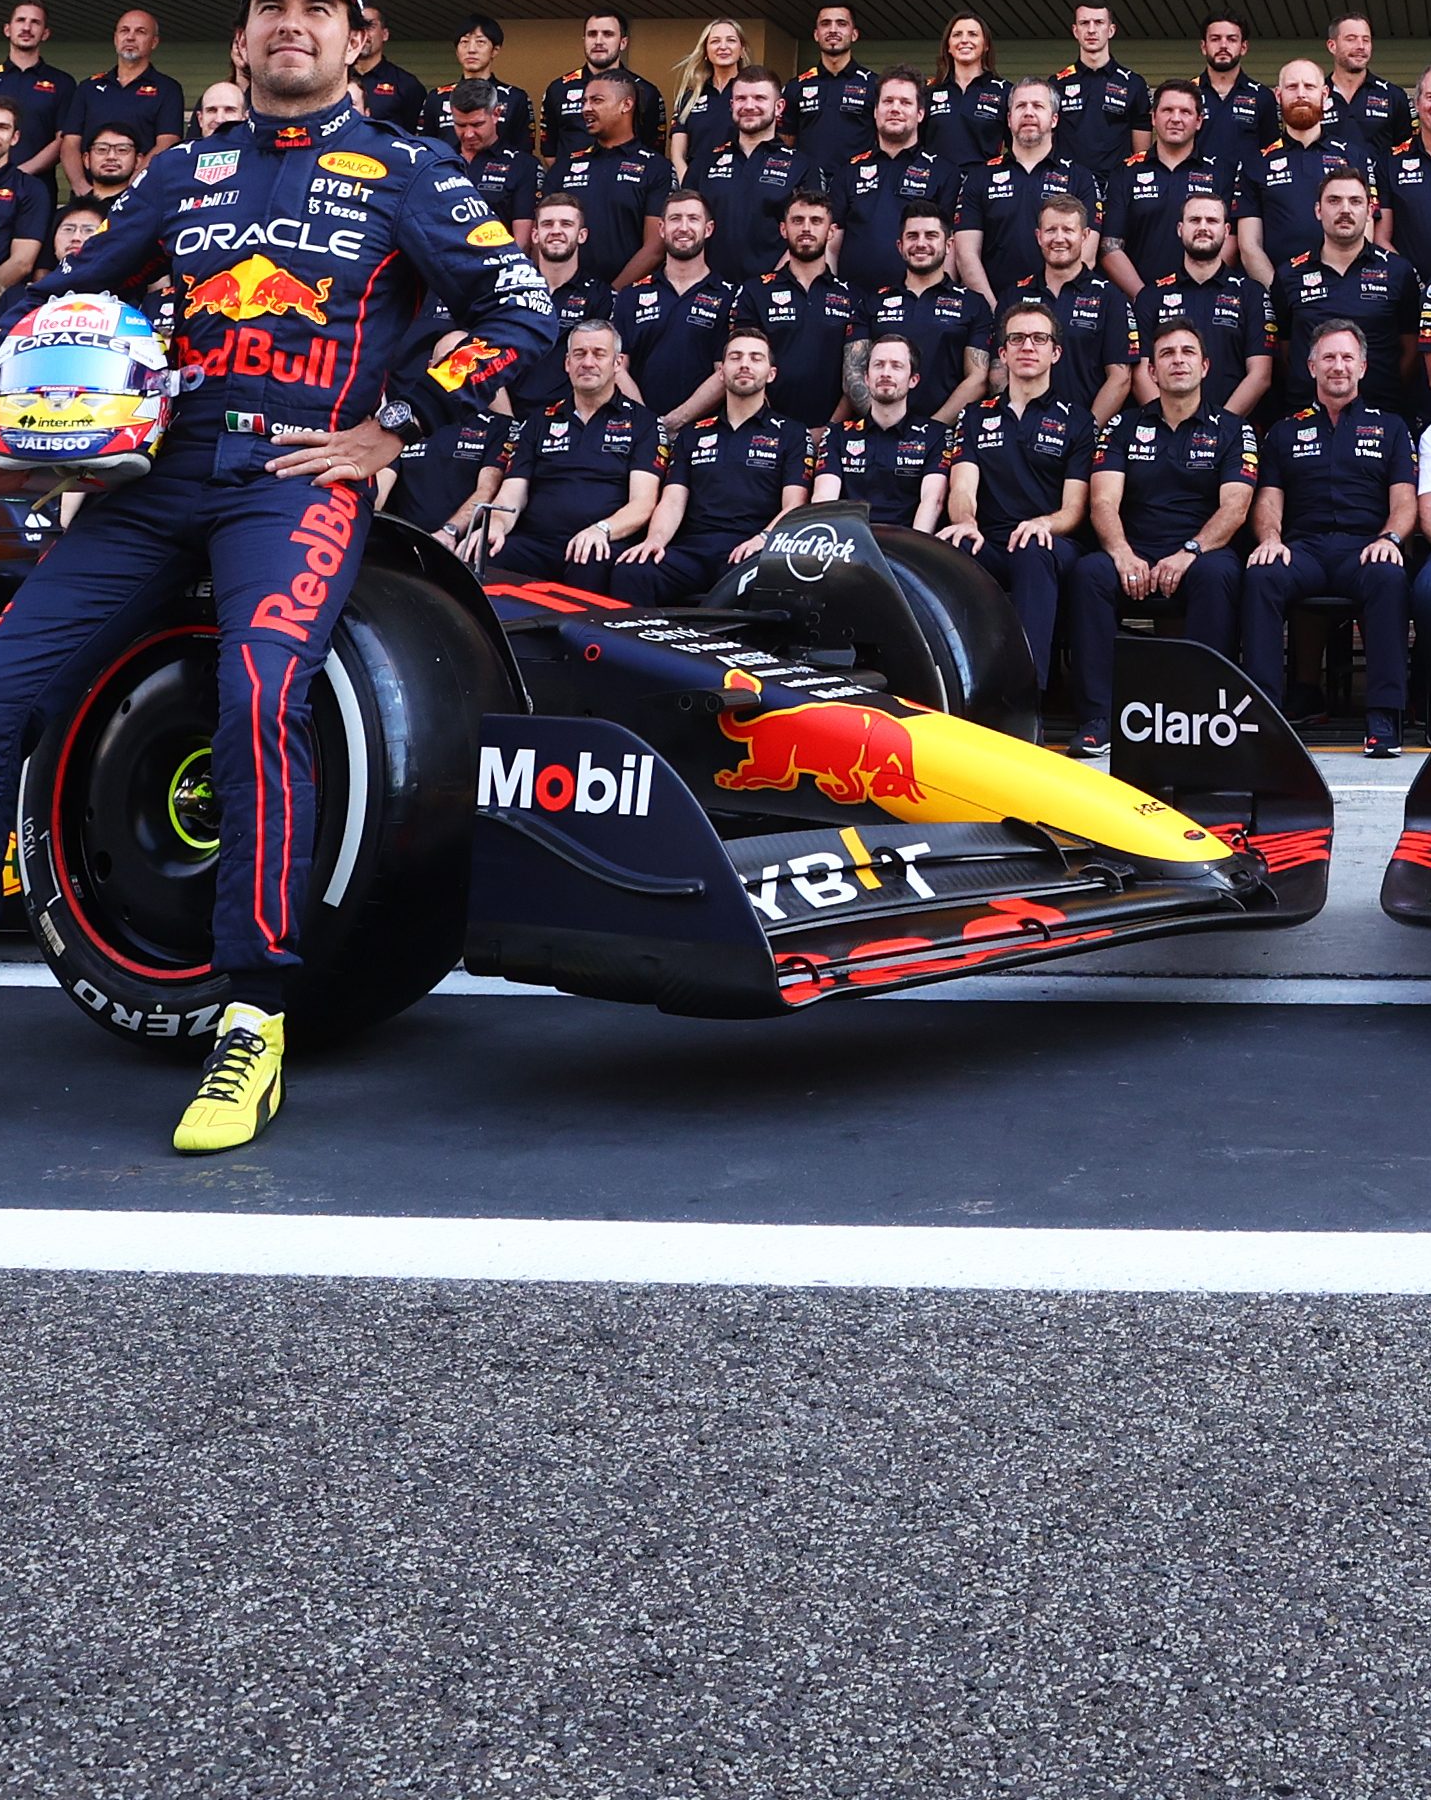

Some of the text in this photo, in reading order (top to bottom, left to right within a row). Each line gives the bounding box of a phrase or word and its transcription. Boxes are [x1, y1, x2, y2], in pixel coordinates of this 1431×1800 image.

[200, 152, 236, 166] TAG
[337, 159, 378, 176] RAUCH
[310, 178, 373, 202] BYBIT
[178, 192, 222, 213] Mobil
[324, 201, 367, 222] Tezos
[175, 218, 365, 260] ORACLE
[38, 315, 110, 331] Red Bull
[17, 332, 127, 353] ORACLE
[232, 327, 339, 389] Bull
[37, 417, 94, 428] inter.mx
[16, 437, 90, 451] JALISCO
[769, 533, 812, 555] Hard
[251, 525, 344, 642] Red
[1119, 699, 1239, 748] Claro
[477, 747, 655, 817] Mobil
